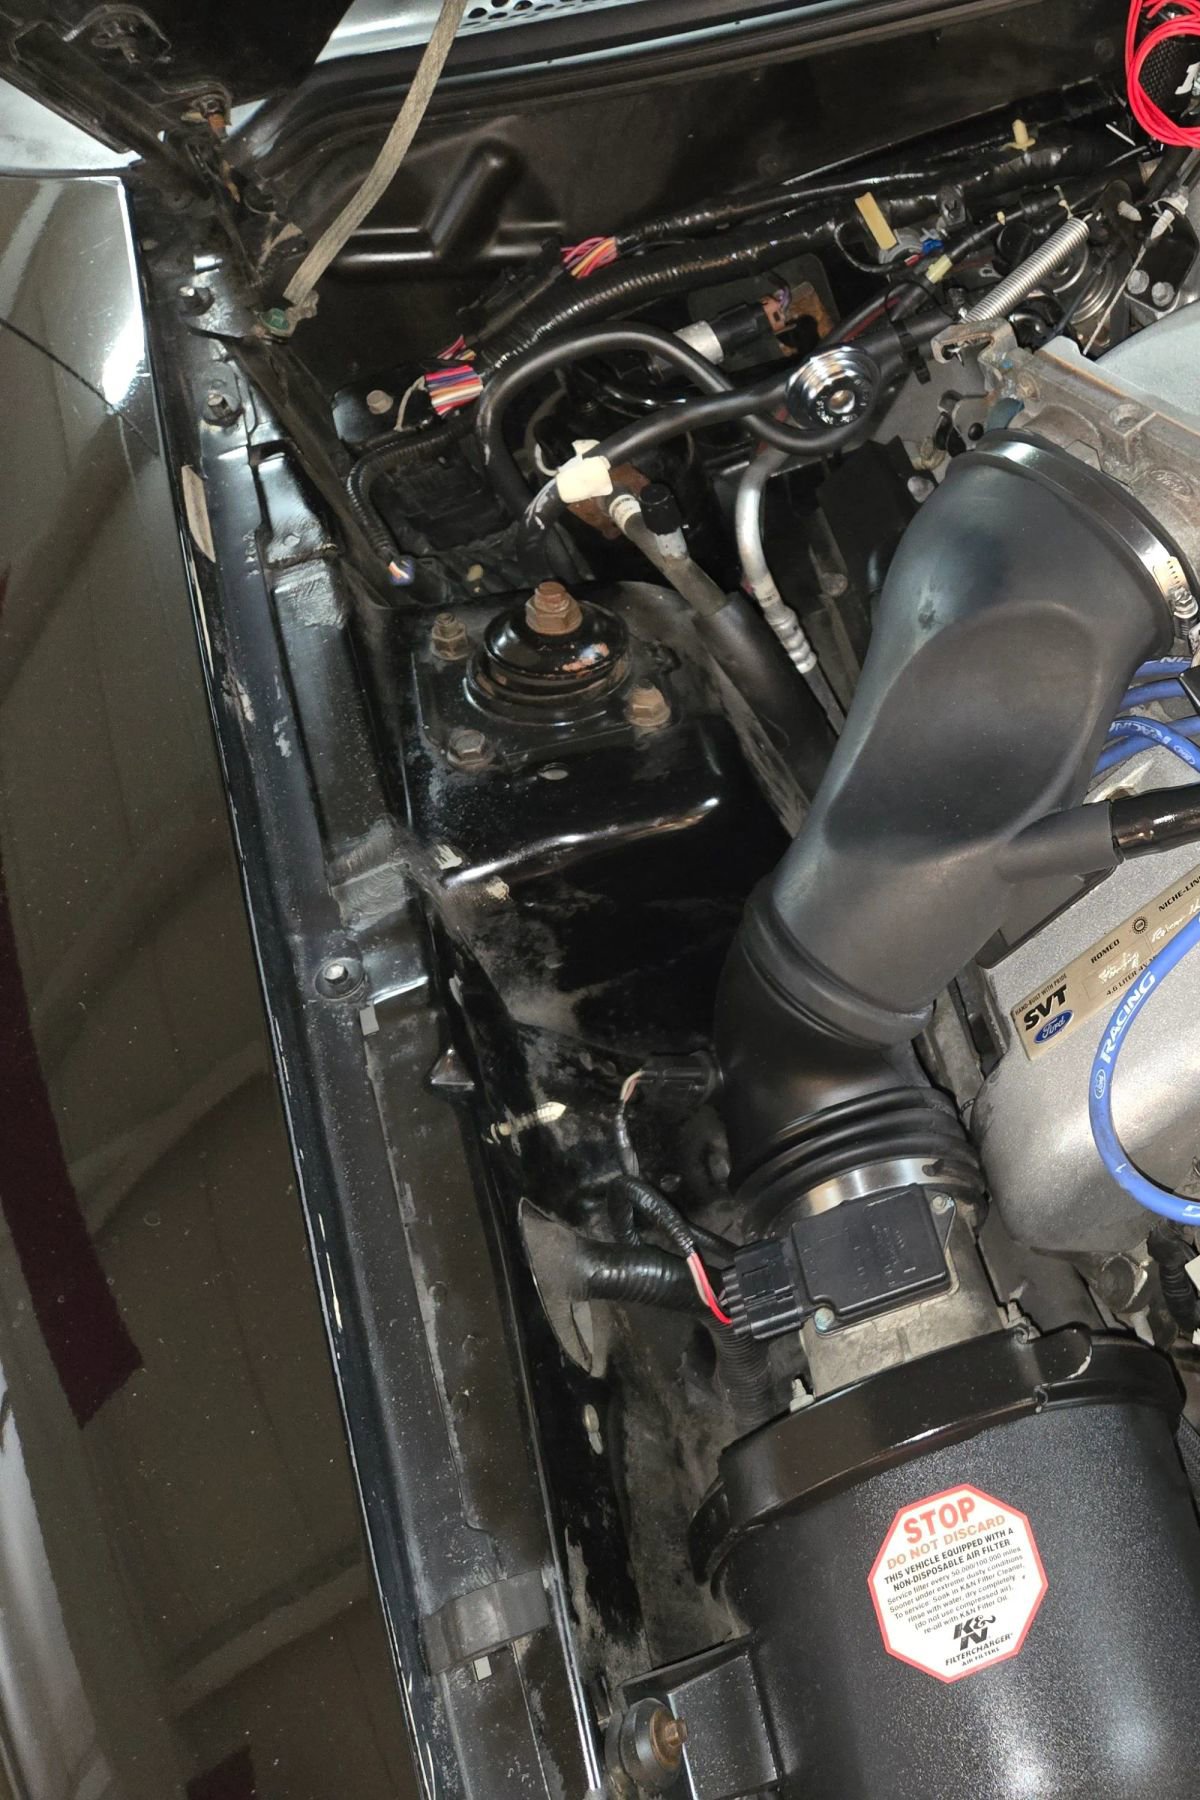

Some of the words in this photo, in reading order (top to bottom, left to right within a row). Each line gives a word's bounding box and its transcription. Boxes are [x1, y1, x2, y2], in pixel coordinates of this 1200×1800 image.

[1090, 938, 1121, 964] ROMEO
[1041, 982, 1054, 995] WITH
[1107, 986, 1118, 996] 4.6
[1119, 970, 1138, 987] LITER
[1023, 983, 1068, 1032] SVT
[1040, 1015, 1066, 1039] Ford
[1100, 971, 1156, 1064] RACING
[886, 1554, 907, 1570] DO
[909, 1538, 941, 1560] NOT
[943, 1514, 1006, 1546] DISCARD
[903, 1496, 976, 1545] STOP
[884, 1570, 904, 1584] THIS
[905, 1554, 940, 1575] VEHICLE
[942, 1538, 984, 1559] EQUIPPED
[984, 1530, 1006, 1543] WITH
[893, 1555, 965, 1591] NON-DISPOSABLE
[965, 1549, 980, 1561] AIR
[982, 1539, 1011, 1554] FILTER
[887, 1589, 913, 1605] Service
[913, 1581, 929, 1593] filter
[930, 1573, 950, 1586] every
[889, 1597, 914, 1613] Sooner
[915, 1588, 935, 1602] under
[936, 1577, 964, 1592] extreme
[966, 1568, 986, 1580] dusty
[894, 1611, 903, 1620] To
[933, 1591, 950, 1602] Soak
[951, 1587, 959, 1595] in
[960, 1580, 977, 1591] K&N
[977, 1573, 995, 1584] Filter
[907, 1611, 925, 1623] rinse
[926, 1603, 942, 1615] with
[965, 1590, 977, 1599] dry
[978, 1574, 1016, 1594] completely
[928, 1613, 940, 1623] not
[941, 1608, 955, 1617] use
[955, 1590, 999, 1612] compressed
[943, 1614, 959, 1626] with
[959, 1607, 976, 1618] K&N
[977, 1599, 995, 1611] Filter
